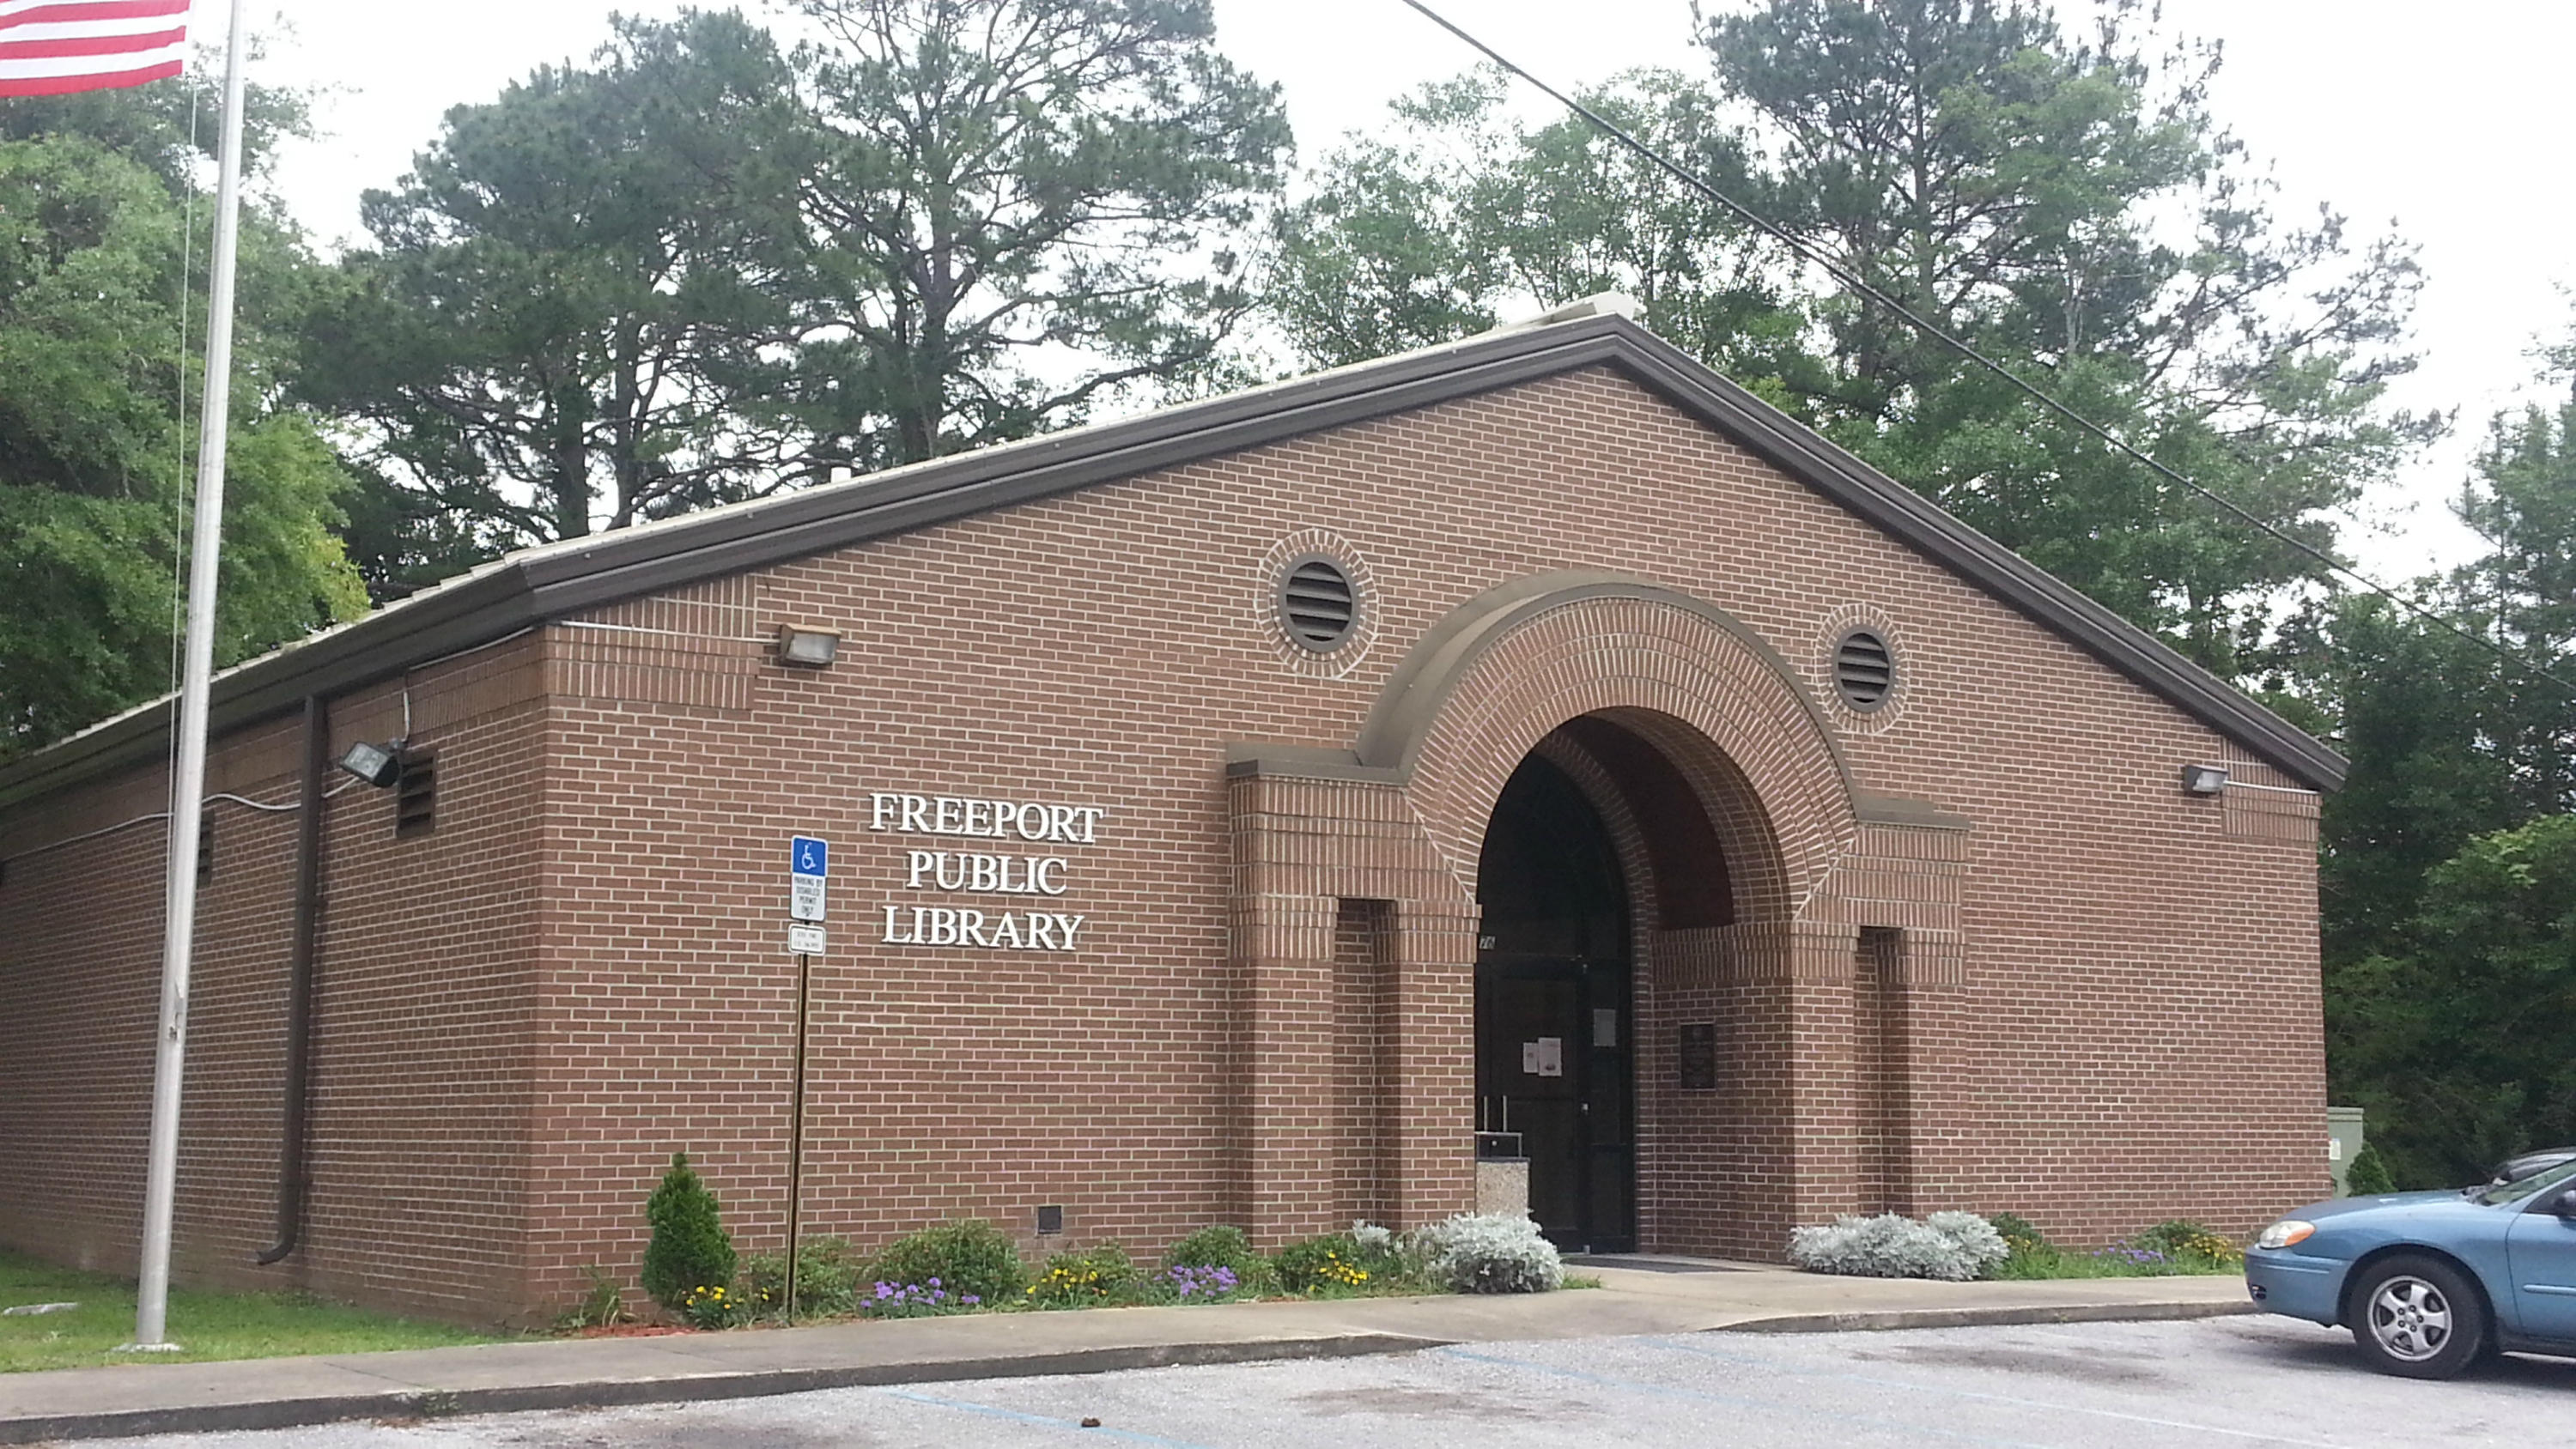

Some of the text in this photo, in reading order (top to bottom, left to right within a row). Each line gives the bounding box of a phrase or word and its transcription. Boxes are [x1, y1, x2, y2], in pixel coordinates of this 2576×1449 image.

[869, 793, 1103, 843] FREEPORT
[906, 851, 1067, 894] PUBLIC
[882, 906, 1084, 950] LIBRARY
